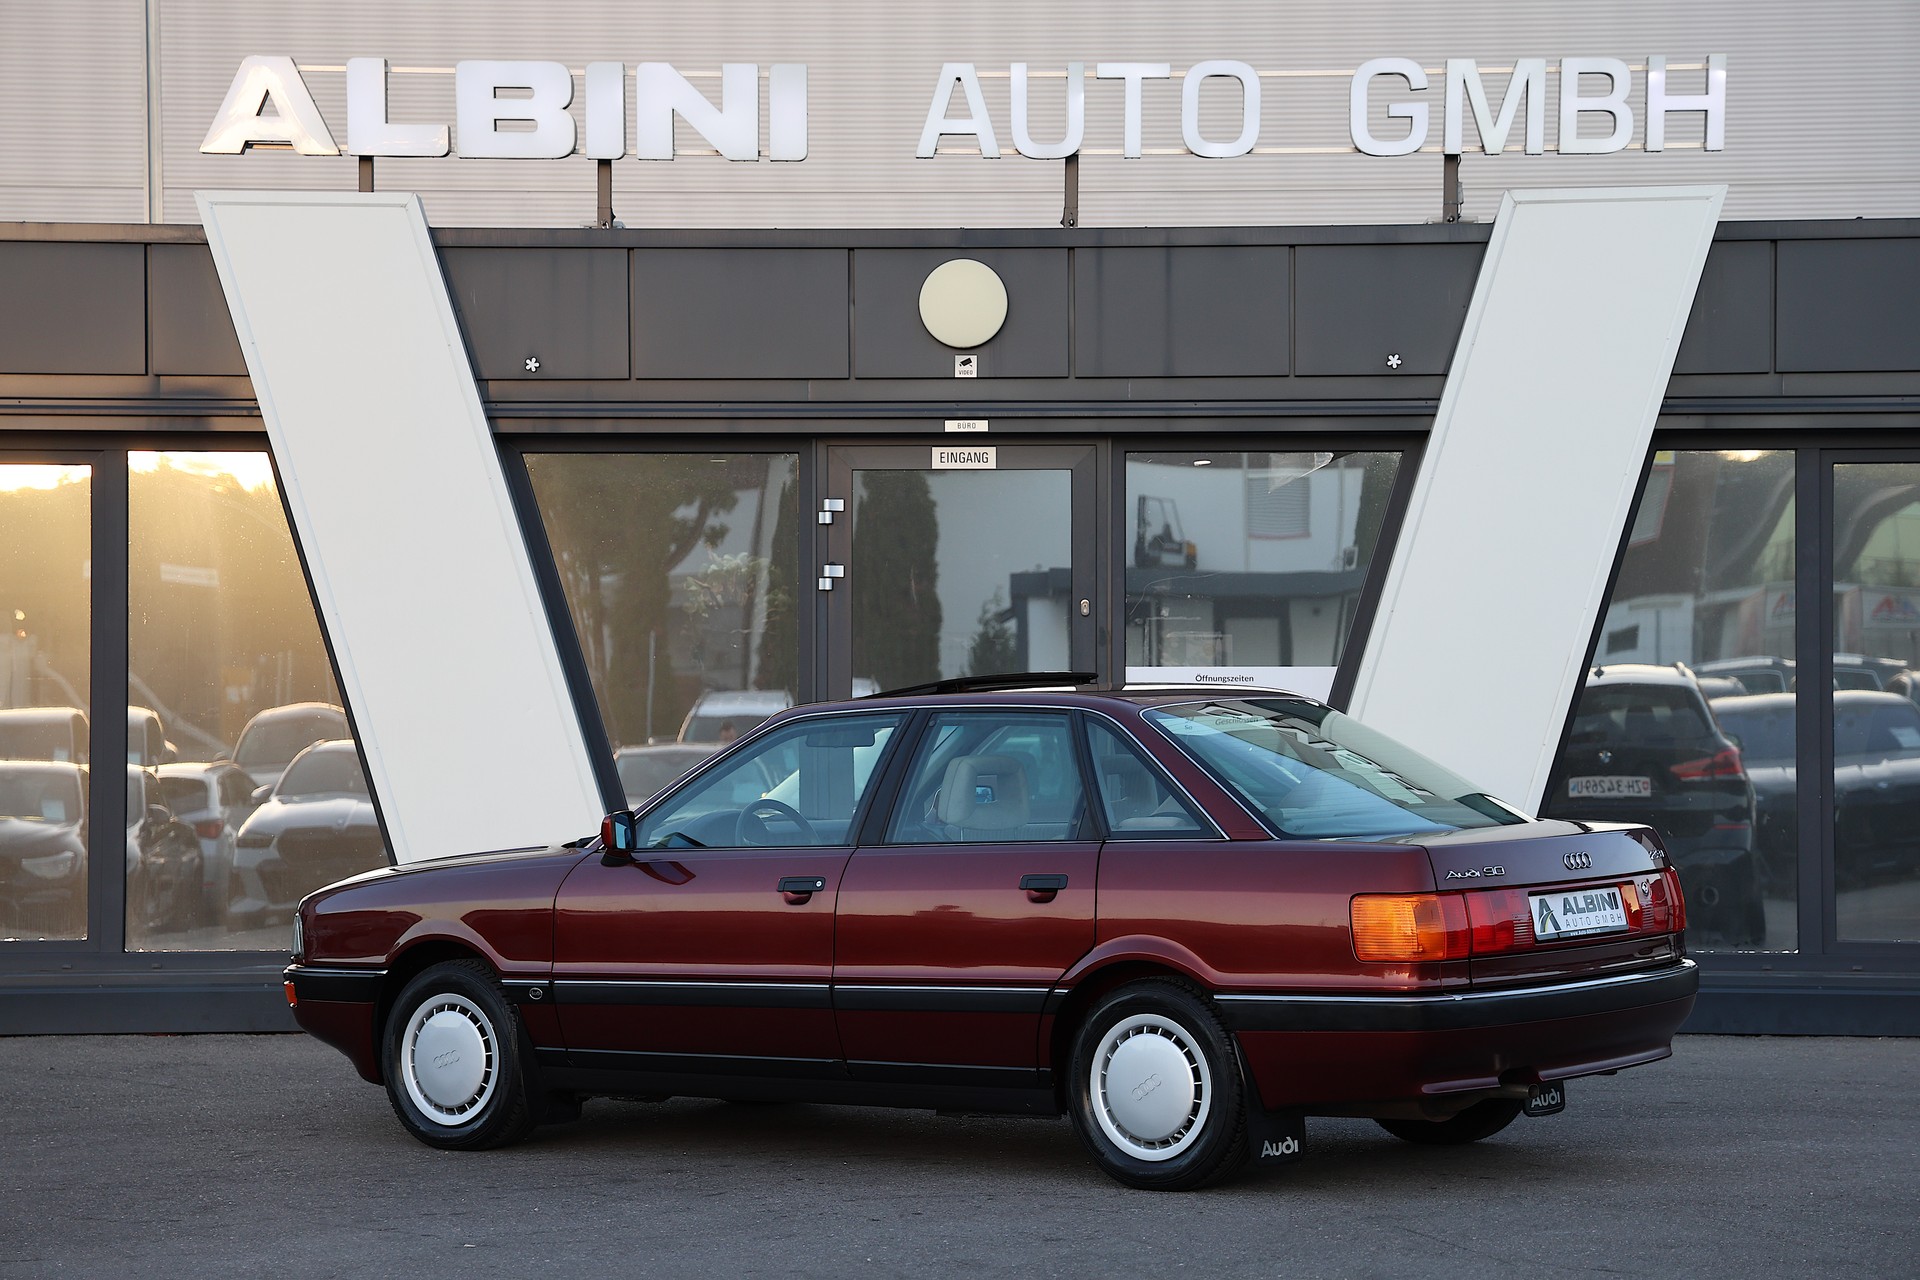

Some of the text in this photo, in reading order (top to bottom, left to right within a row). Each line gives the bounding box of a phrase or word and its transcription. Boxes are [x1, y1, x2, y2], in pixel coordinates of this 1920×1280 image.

[199, 53, 1727, 162] ALBINI AUTO GMBH
[957, 421, 977, 430] BÜRO
[939, 451, 989, 464] EINGANG
[1195, 674, 1254, 683] Öffnungszeiten
[1445, 865, 1505, 880] Audi 90
[1563, 892, 1619, 916] ALBINI
[1565, 913, 1623, 929] AUTO GMBH
[1530, 1088, 1561, 1108] Audi
[1261, 1136, 1299, 1158] Audi
